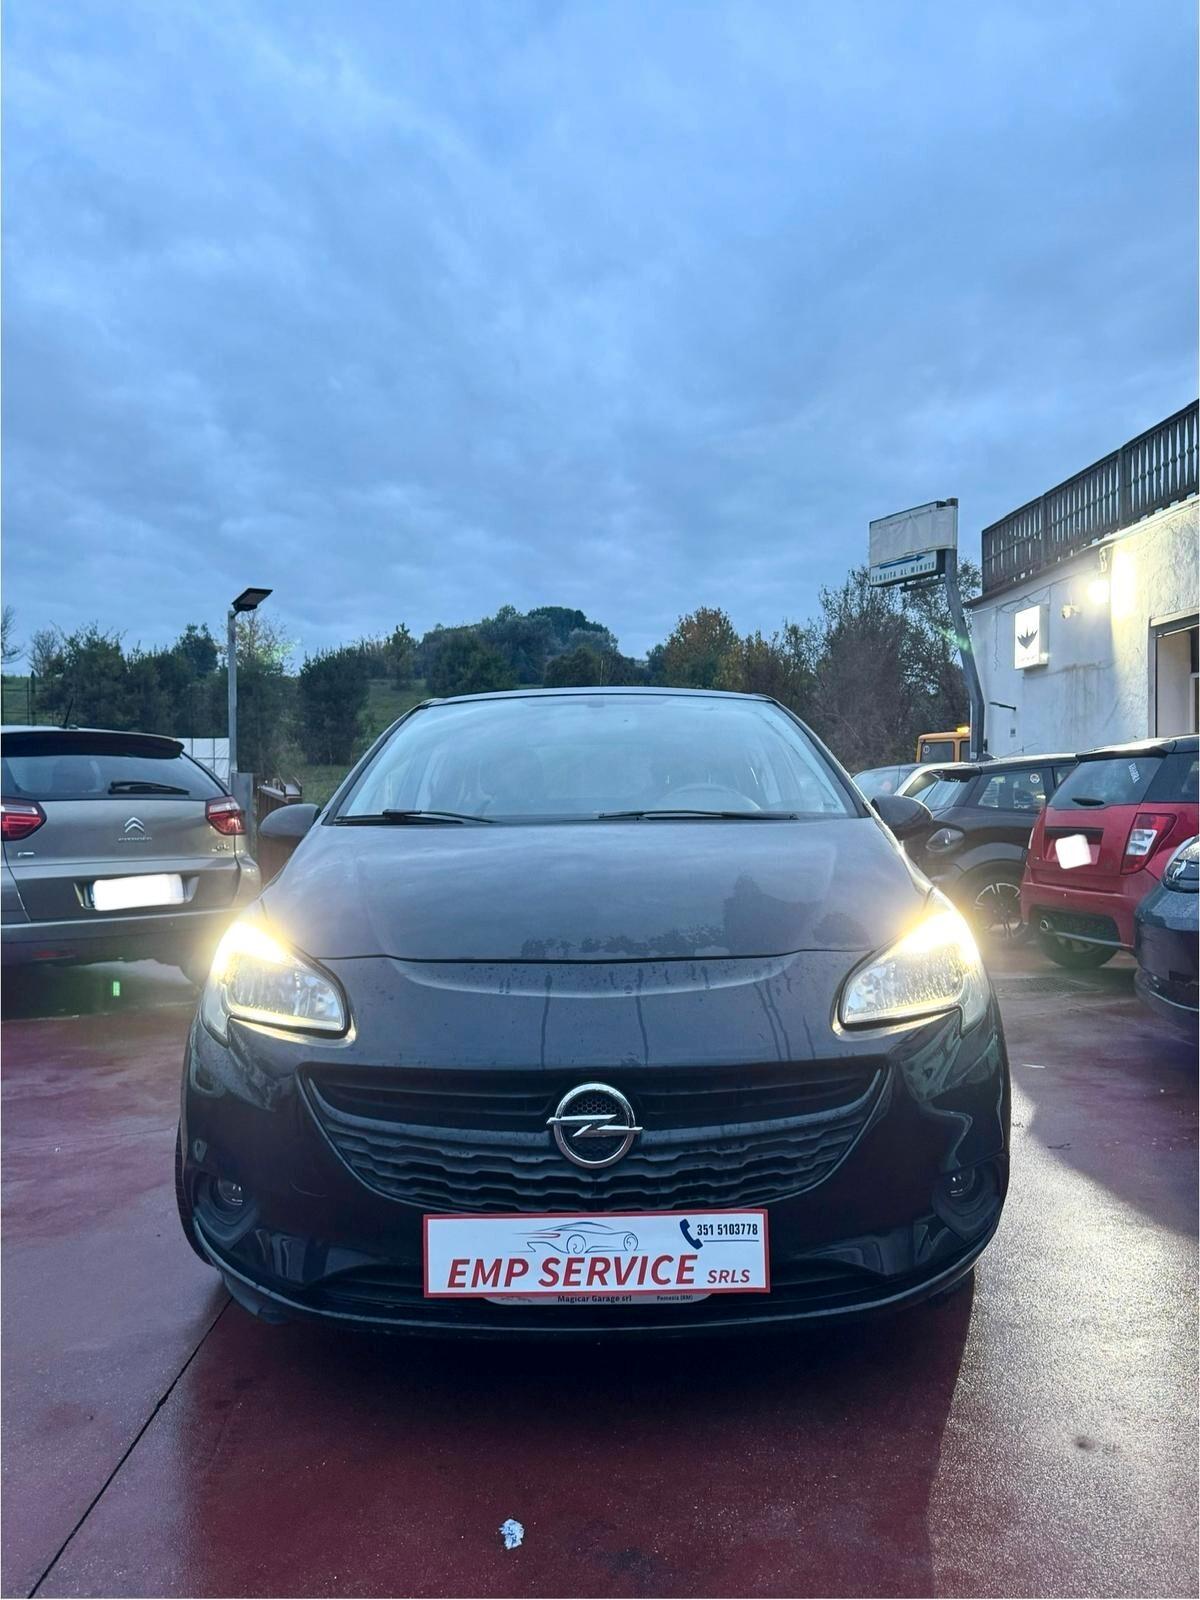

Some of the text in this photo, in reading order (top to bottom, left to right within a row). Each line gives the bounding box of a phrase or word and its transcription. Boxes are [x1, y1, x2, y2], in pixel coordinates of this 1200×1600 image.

[697, 1223, 758, 1236] 351 5103778
[447, 1254, 750, 1288] EMP SERVICE SRLS
[557, 1295, 590, 1303] Magicar
[591, 1295, 620, 1303] Garage
